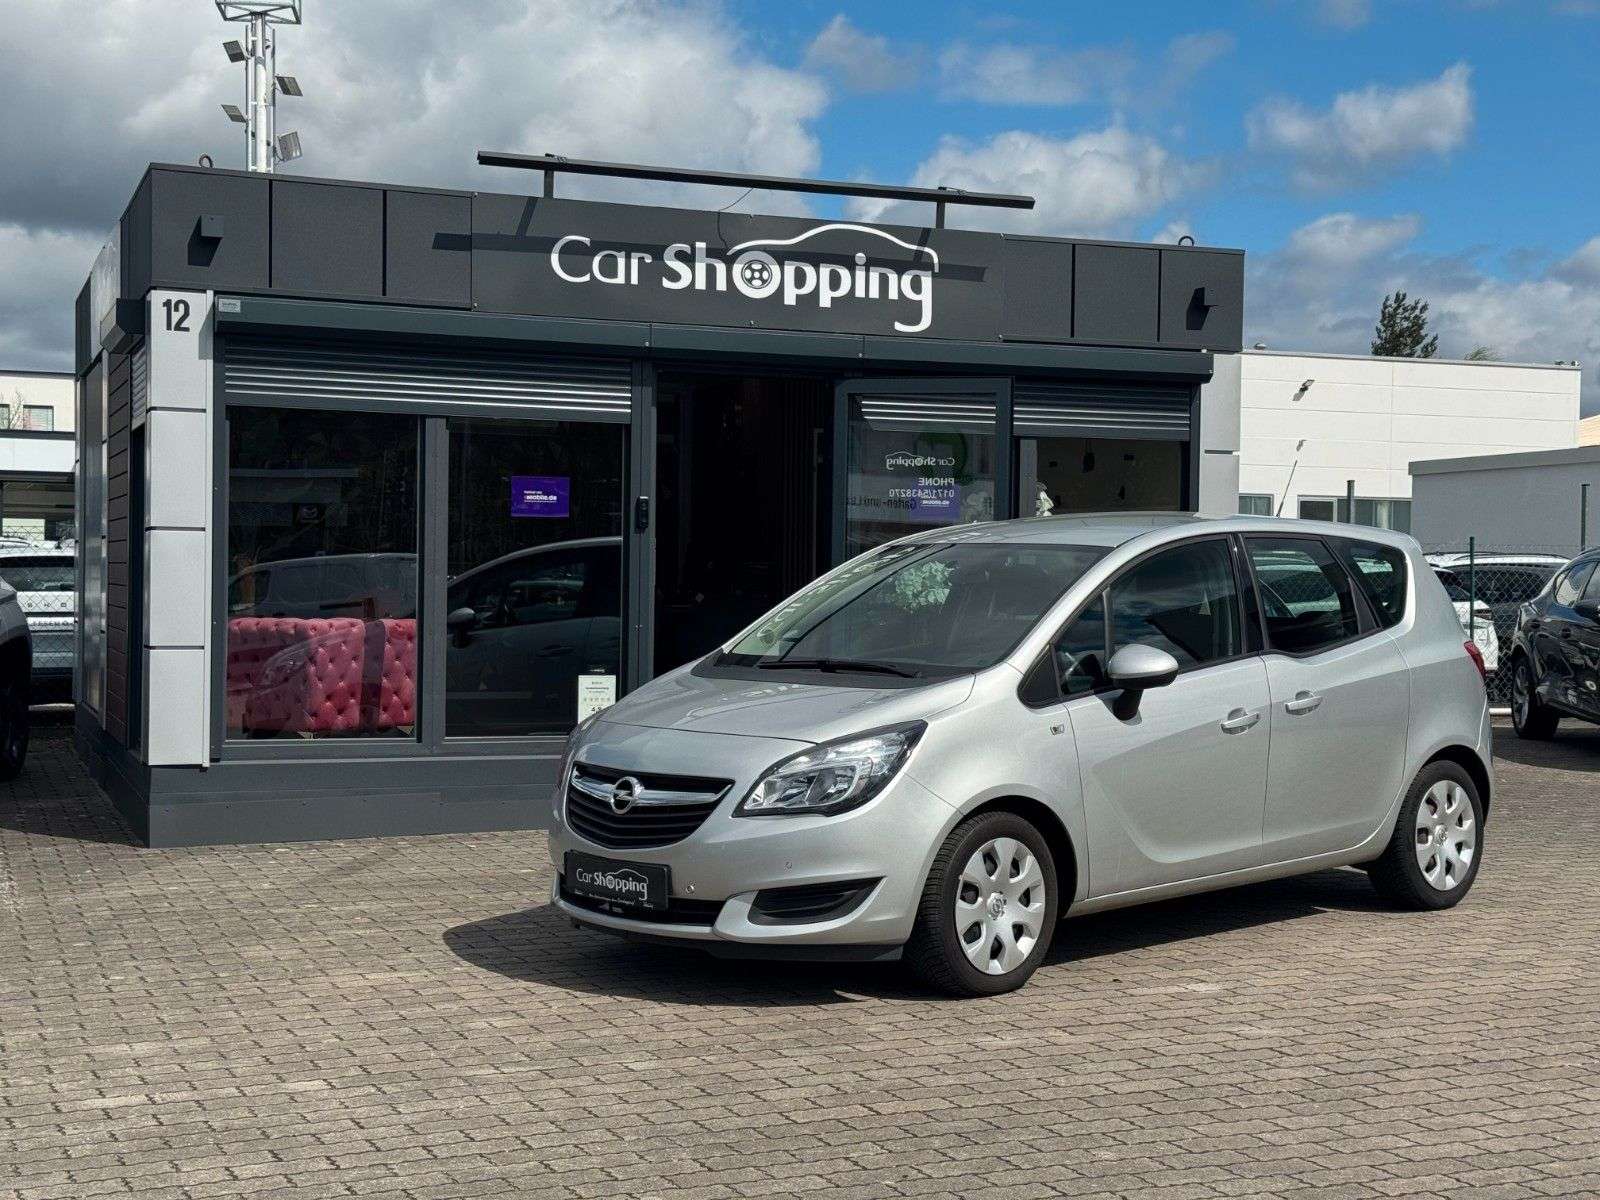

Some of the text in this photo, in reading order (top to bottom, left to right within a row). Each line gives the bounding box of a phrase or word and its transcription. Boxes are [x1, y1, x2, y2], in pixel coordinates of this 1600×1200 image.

[550, 235, 933, 333] Car Shopping
[162, 299, 190, 332] 12
[576, 868, 592, 882] Car
[593, 871, 649, 901] Shopping
